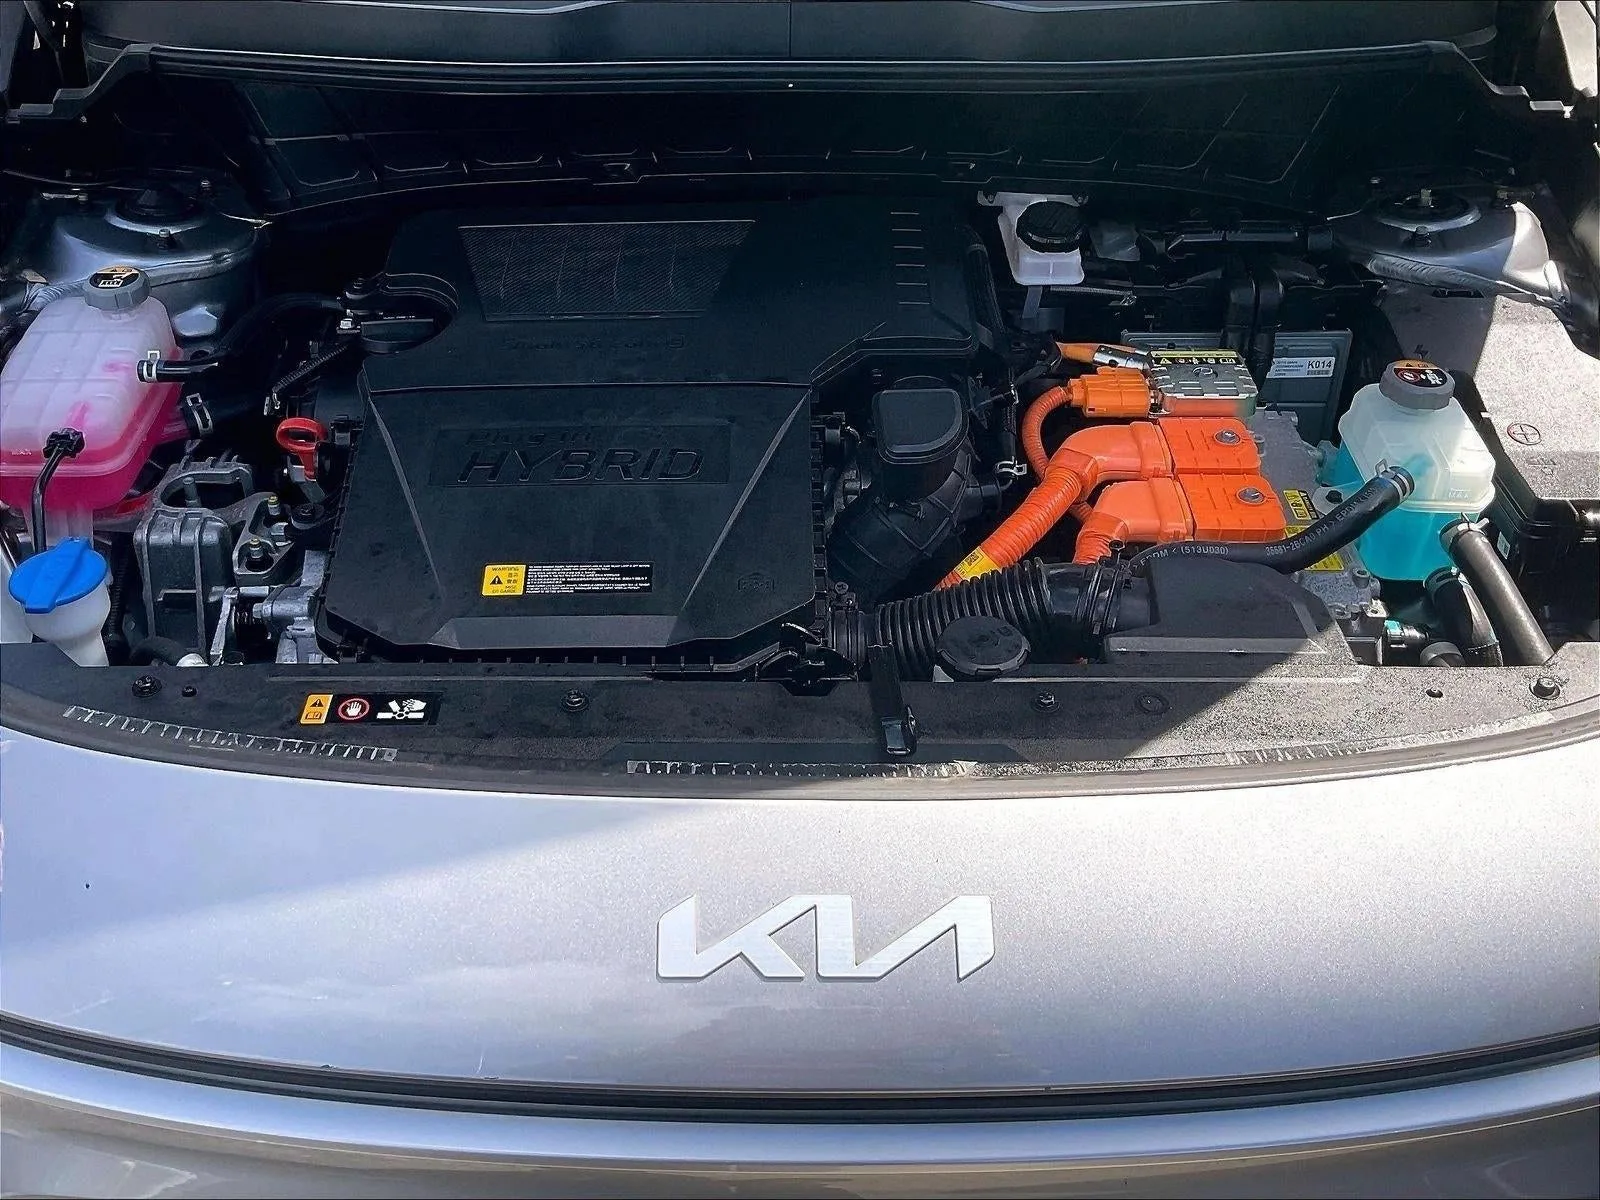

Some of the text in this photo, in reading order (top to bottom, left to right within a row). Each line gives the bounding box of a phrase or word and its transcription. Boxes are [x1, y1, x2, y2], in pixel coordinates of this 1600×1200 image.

[1307, 360, 1332, 369] K014
[457, 449, 705, 483] HYBRID
[656, 894, 995, 983] KIA
